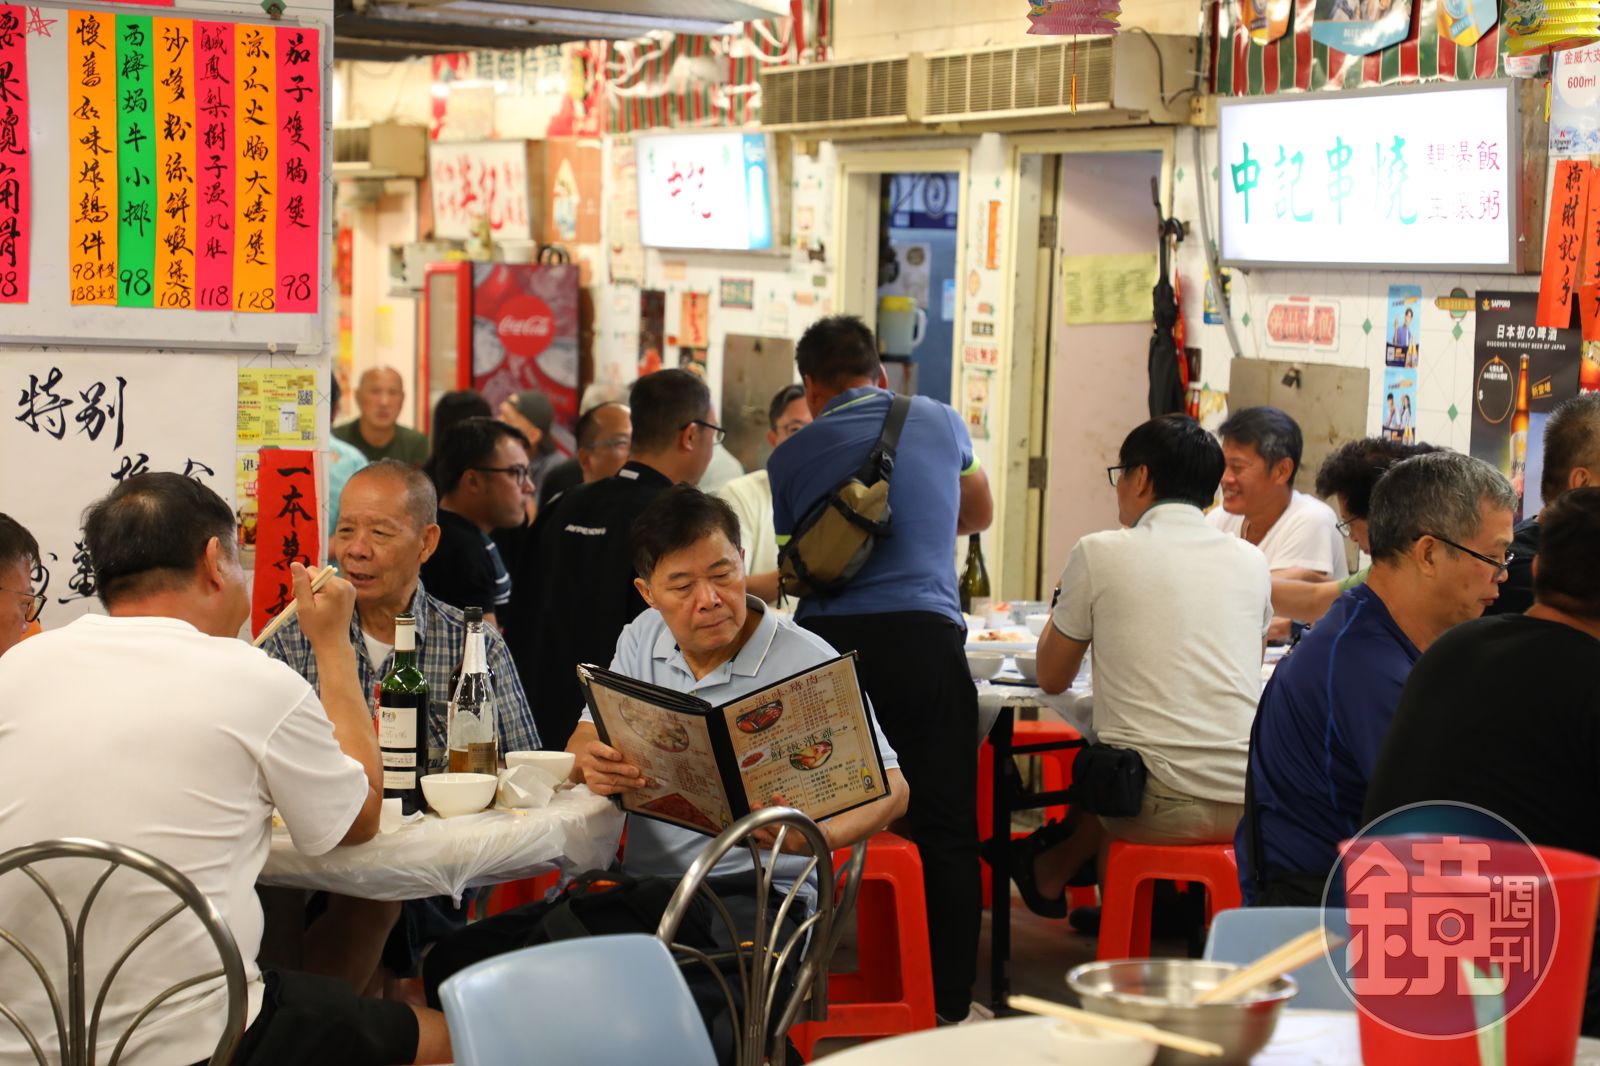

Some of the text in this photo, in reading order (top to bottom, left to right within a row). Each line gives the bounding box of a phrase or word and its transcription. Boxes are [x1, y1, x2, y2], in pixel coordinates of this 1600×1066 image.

[1567, 75, 1596, 88] 600ml
[1231, 135, 1417, 224] 中記串燒
[0, 271, 18, 297] 8
[120, 269, 151, 297] 98
[281, 273, 310, 300] 98
[160, 290, 191, 309] 108
[200, 285, 229, 306] 118
[237, 288, 275, 310] 128
[1491, 299, 1511, 308] SAPPORO
[15, 367, 127, 451] 特別
